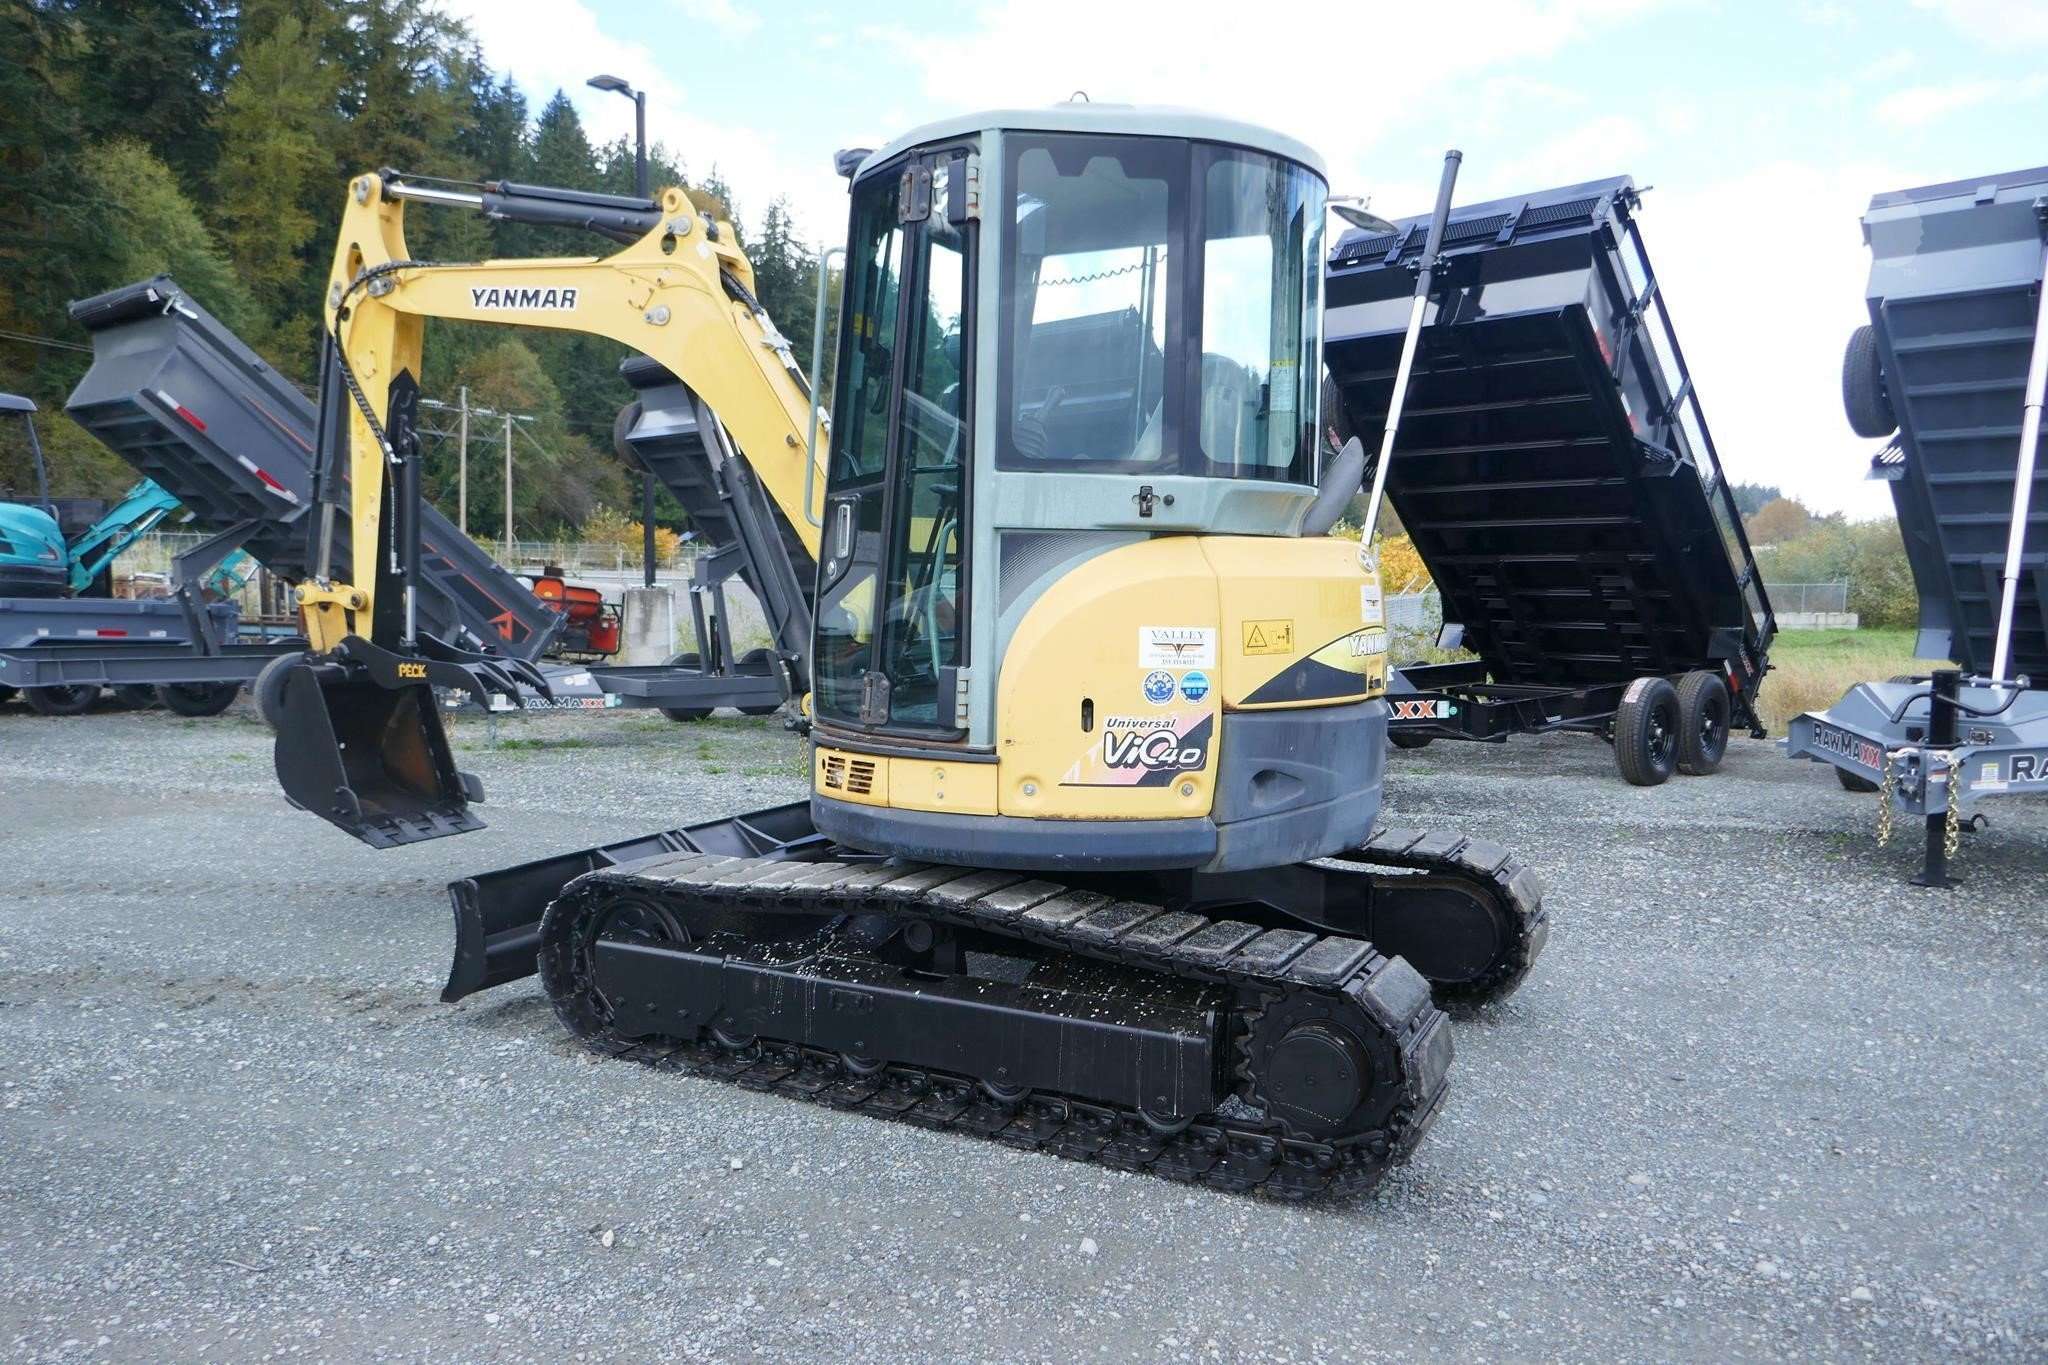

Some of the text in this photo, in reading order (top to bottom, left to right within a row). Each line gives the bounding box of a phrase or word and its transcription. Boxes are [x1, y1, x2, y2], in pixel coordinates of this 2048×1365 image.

[471, 287, 577, 309] YANMAR
[1151, 630, 1205, 640] VALLEY
[399, 663, 427, 678] PECK
[1106, 718, 1177, 729] Universal
